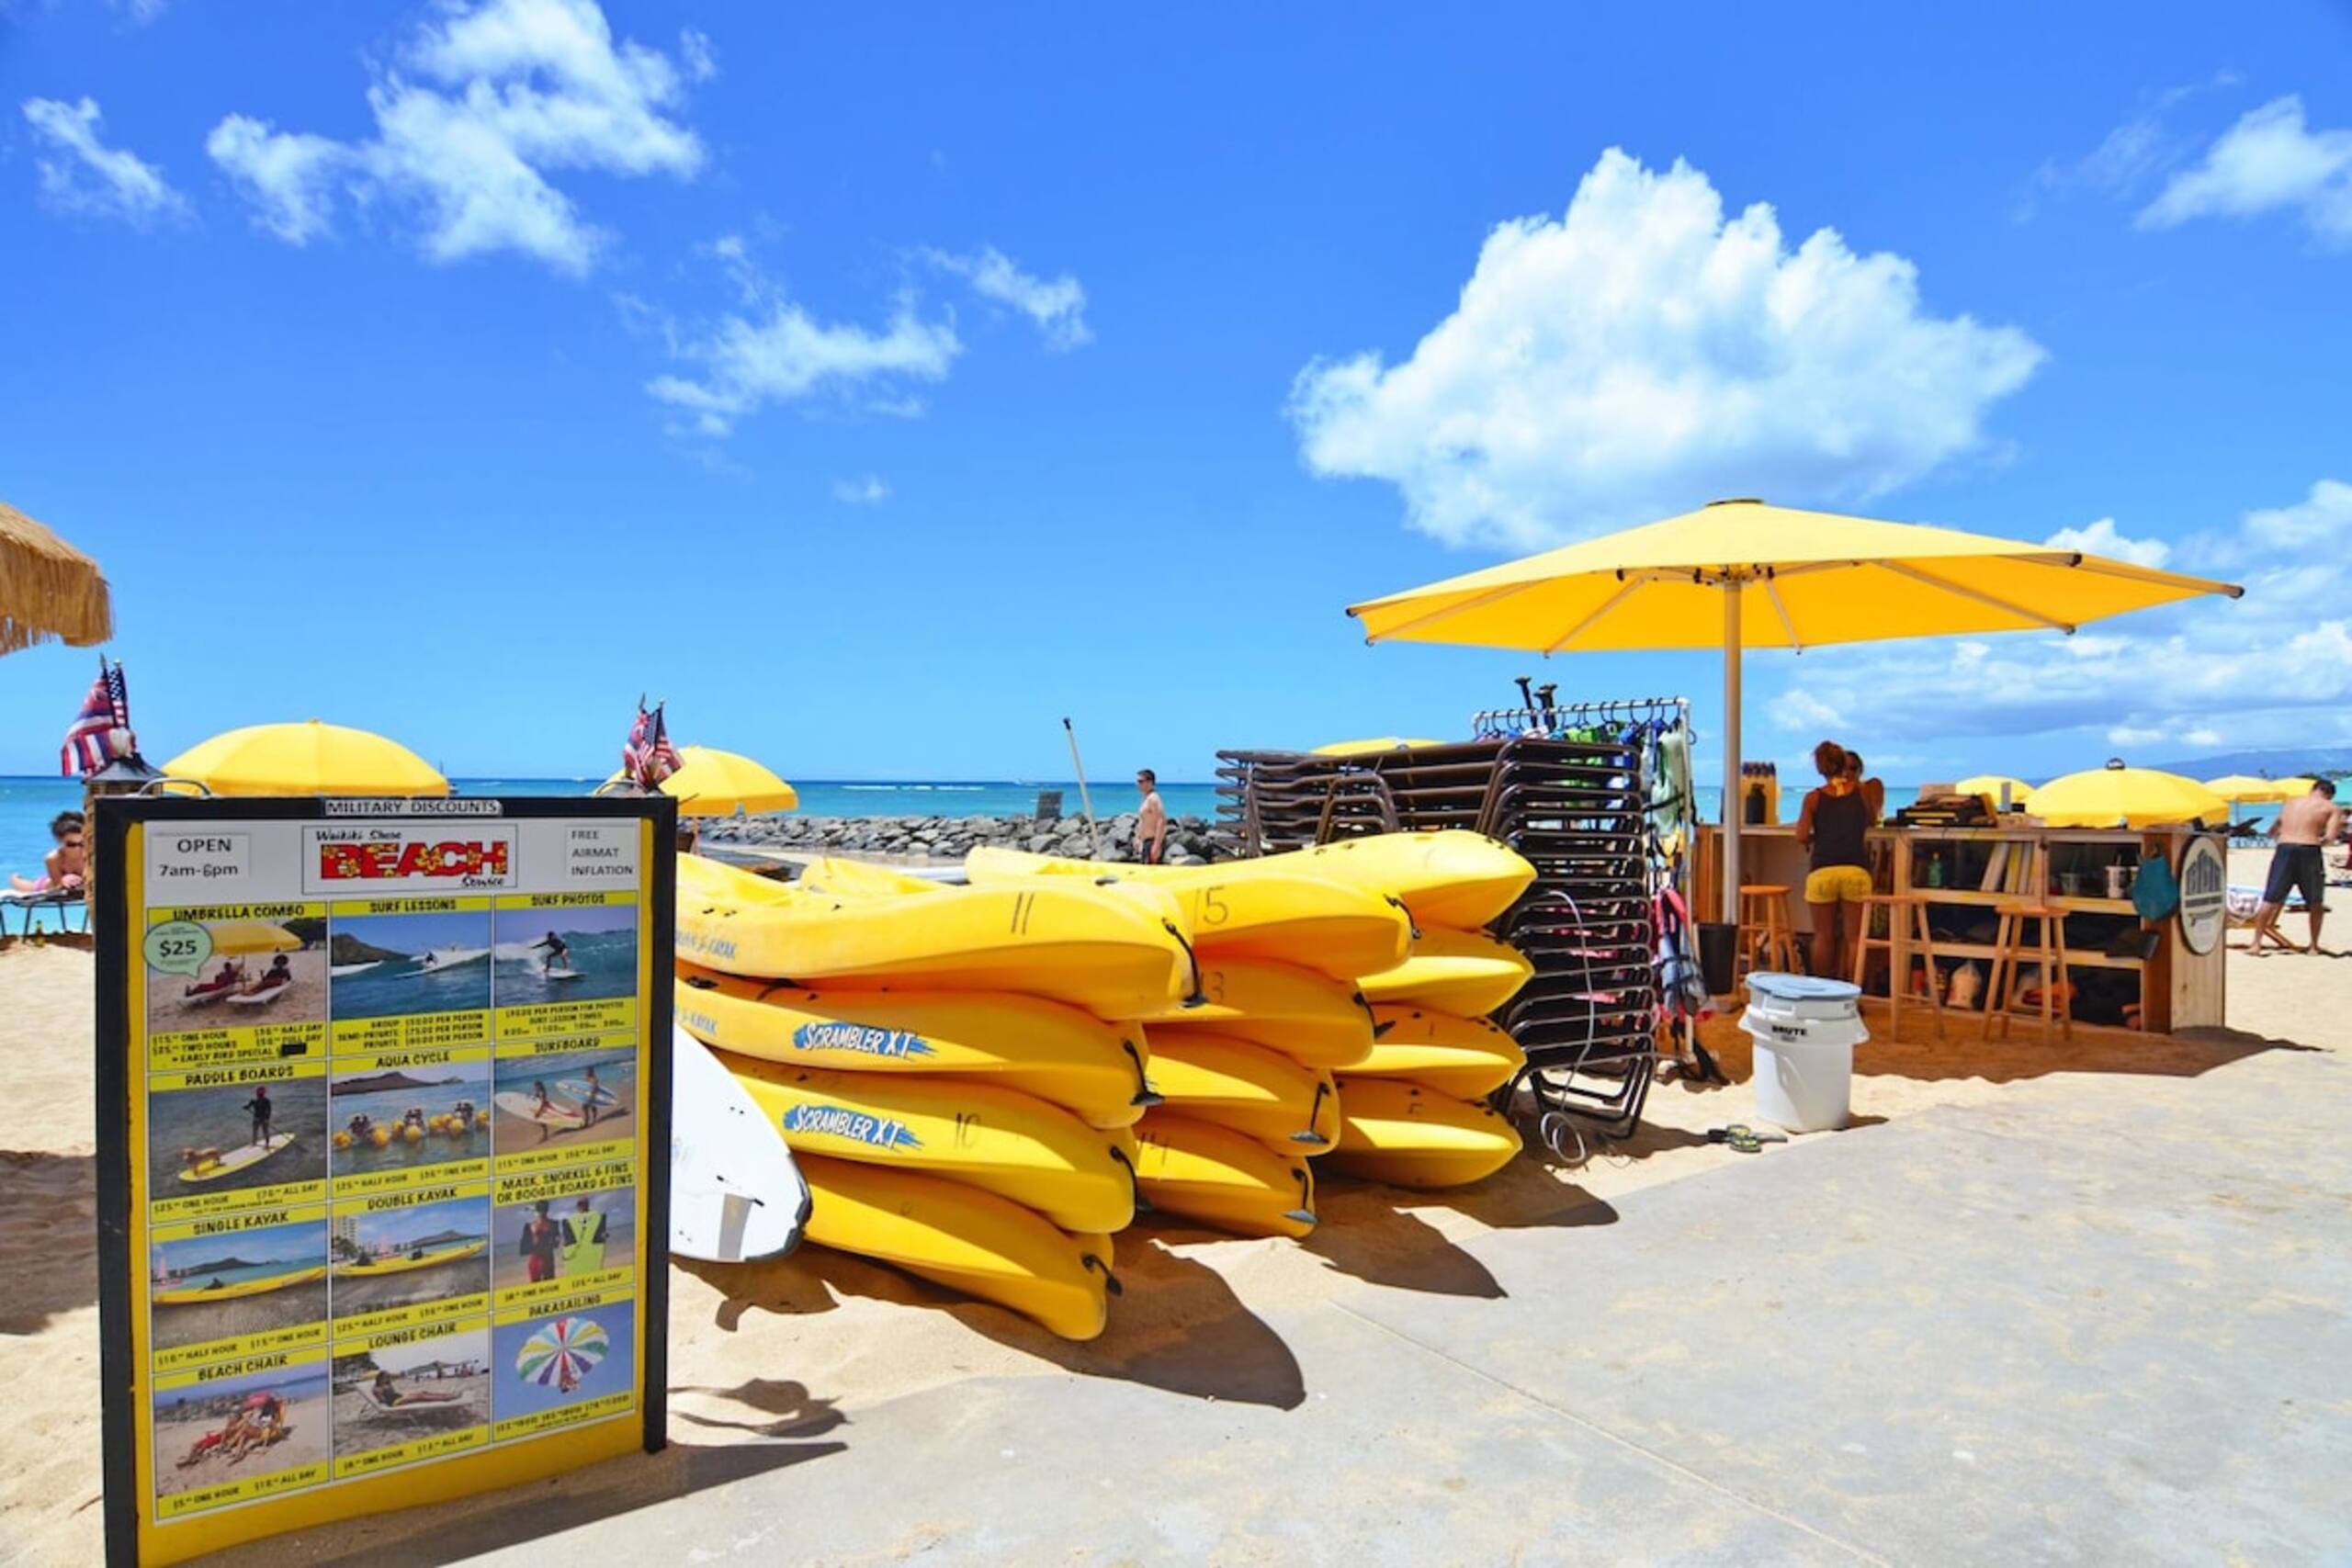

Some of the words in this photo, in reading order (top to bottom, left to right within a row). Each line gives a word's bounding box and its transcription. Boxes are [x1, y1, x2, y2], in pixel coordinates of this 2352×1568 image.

[328, 800, 402, 813] MILITARY
[411, 800, 497, 813] DISCOUNTS
[316, 829, 364, 841] Waikiki
[571, 830, 599, 840] FREE
[177, 839, 232, 852] OPEN
[571, 848, 619, 858] AIRMAT
[321, 840, 508, 879] BEACH
[159, 863, 238, 877] 7am-6pm
[571, 865, 633, 875] INFLATION
[369, 901, 399, 913] SURF
[404, 899, 457, 912] LESSONS
[532, 895, 559, 907] SURF
[562, 894, 605, 906] PHOTOS
[173, 907, 251, 920] UMBRELLA
[254, 905, 304, 918] COMBO
[160, 940, 197, 957] $25
[1771, 1024, 1807, 1036] BRUTE
[535, 1037, 601, 1053] SURFBOARD
[805, 1021, 885, 1054] SCRAMBLER
[885, 1030, 916, 1057] XT
[376, 1055, 410, 1068] AQUA
[413, 1052, 450, 1065] CYCLE
[186, 1071, 234, 1086] PADDLE
[240, 1066, 293, 1080] BOARDS
[794, 1103, 872, 1143] SCRAMBLER
[872, 1118, 904, 1149] XT
[543, 1168, 591, 1185] SNORKEL
[605, 1163, 629, 1174] FINS
[496, 1192, 513, 1204] OR
[515, 1185, 556, 1201] BOOGIE
[560, 1179, 596, 1195] BOARD
[609, 1173, 633, 1186] FINS
[368, 1195, 413, 1210] DOUBLE
[417, 1188, 458, 1203] KAYAK
[194, 1218, 239, 1235] SINGLE
[244, 1212, 288, 1228] KAYAK
[529, 1294, 602, 1317] PARASAILING
[368, 1333, 415, 1348] LOUNGE
[419, 1323, 457, 1339] CHAIR
[198, 1363, 243, 1381] BEACH
[246, 1355, 288, 1371] CHAIR
